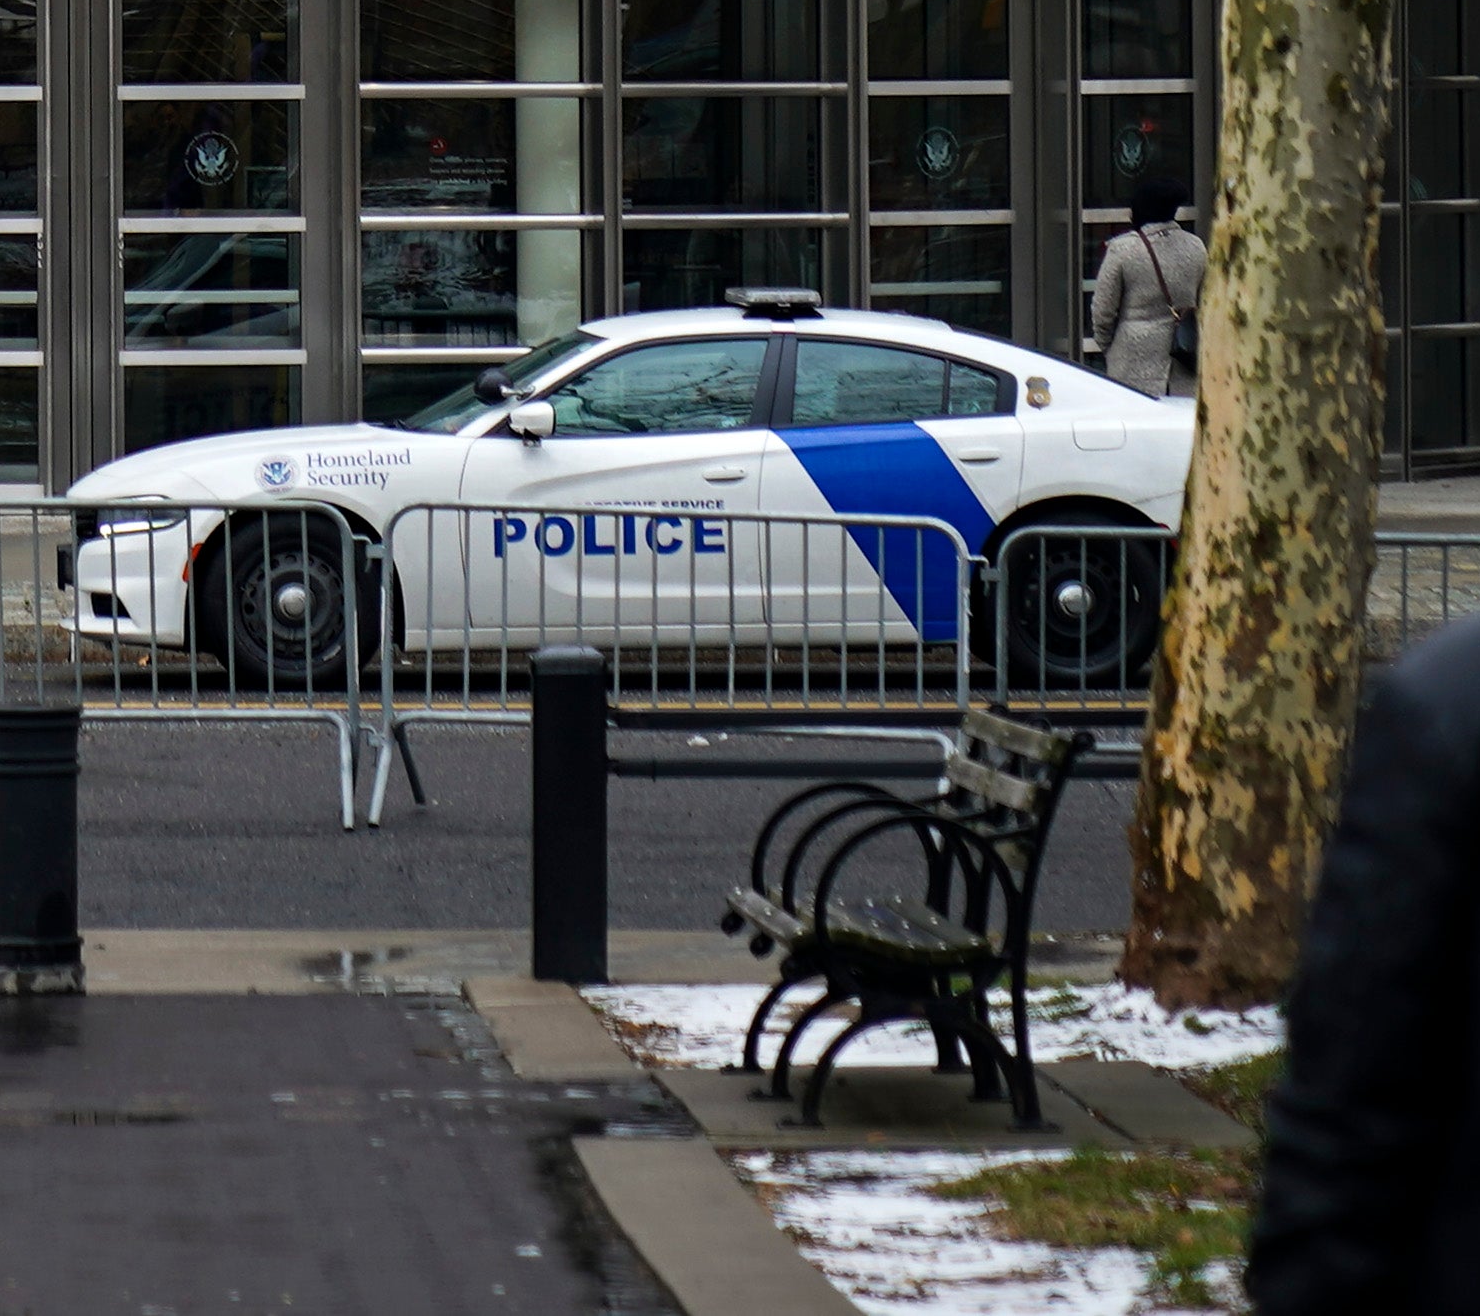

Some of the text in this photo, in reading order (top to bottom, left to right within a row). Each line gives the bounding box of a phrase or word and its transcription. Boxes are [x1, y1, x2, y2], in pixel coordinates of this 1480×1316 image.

[306, 447, 412, 468] Homeland
[307, 468, 390, 491] Security
[493, 512, 726, 558] POLICE
